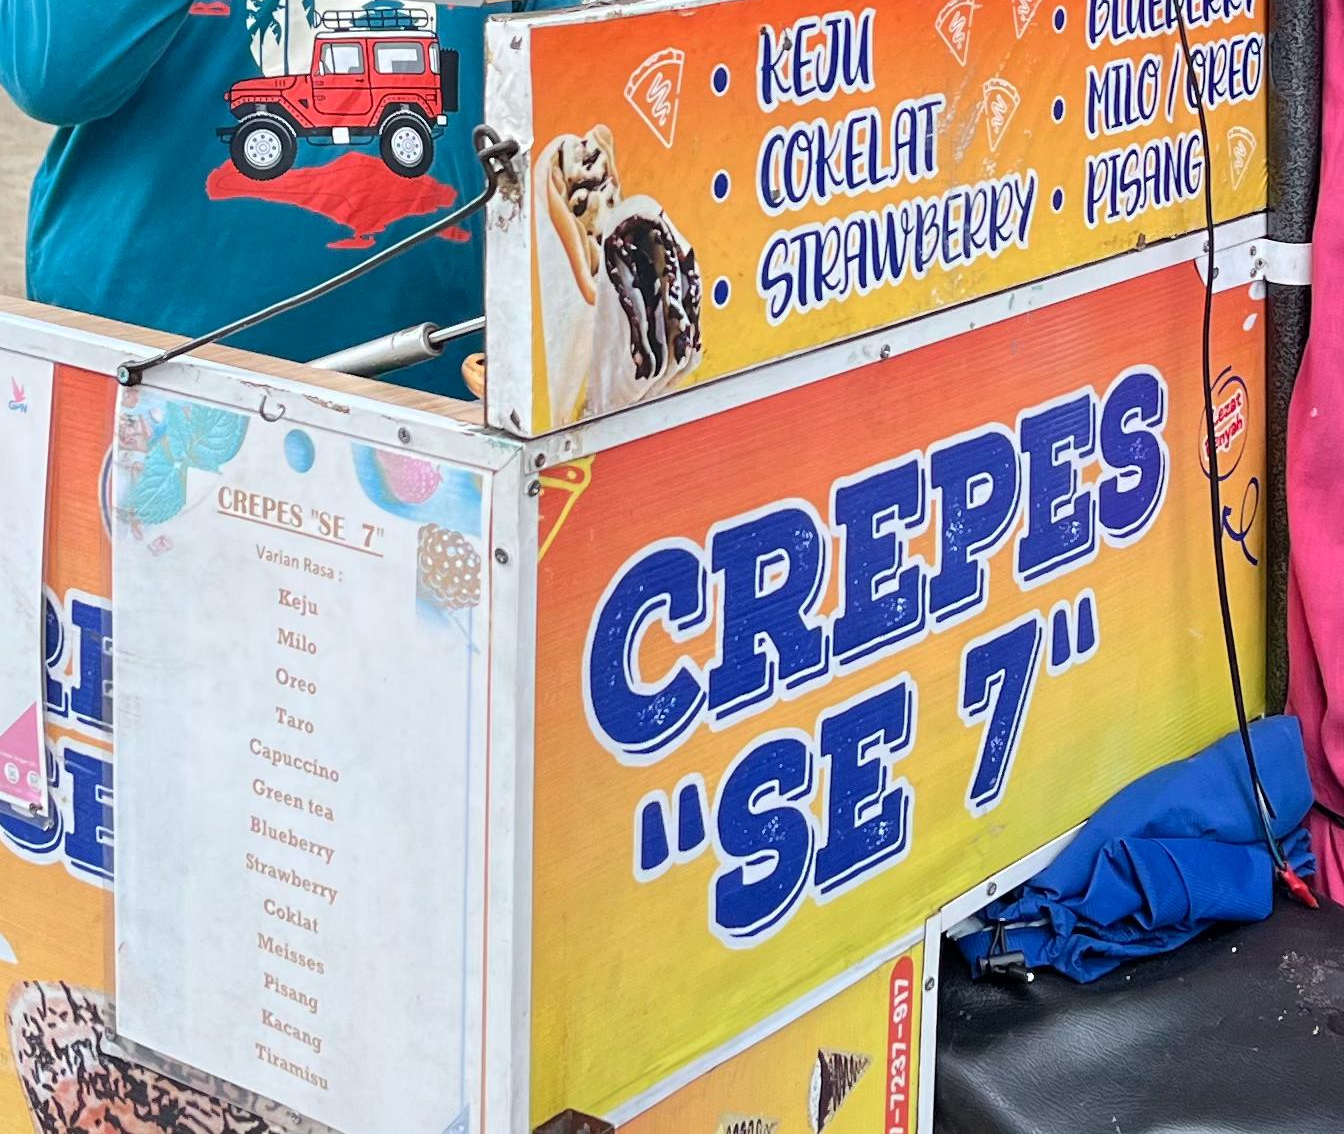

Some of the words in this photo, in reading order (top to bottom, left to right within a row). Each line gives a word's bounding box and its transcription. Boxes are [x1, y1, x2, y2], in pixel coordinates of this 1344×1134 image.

[757, 6, 877, 111] KEJU
[1085, 65, 1161, 139] MILO
[1184, 32, 1266, 116] OREO
[758, 93, 946, 215] COKELAT
[1084, 126, 1205, 227] PISANG
[758, 169, 1039, 327] STRAWBERRY
[216, 484, 306, 529] CREPES
[255, 543, 299, 570] Varian
[302, 554, 336, 580] Rasa
[586, 367, 1167, 760] CREPES
[276, 587, 320, 618] Keju
[276, 627, 318, 656] Milo
[275, 667, 318, 696] Oreo
[274, 706, 315, 735] Taro
[248, 737, 340, 785] Capuccino
[251, 778, 303, 812] Green
[308, 797, 336, 822] tea
[248, 816, 336, 865] Blueberry
[244, 852, 338, 905] Strawberry
[263, 897, 320, 934] Coklat
[256, 933, 325, 975] Meisses
[263, 971, 319, 1015] Pisang
[260, 1008, 323, 1054] Kacang
[254, 1043, 330, 1092] Tiramisu
